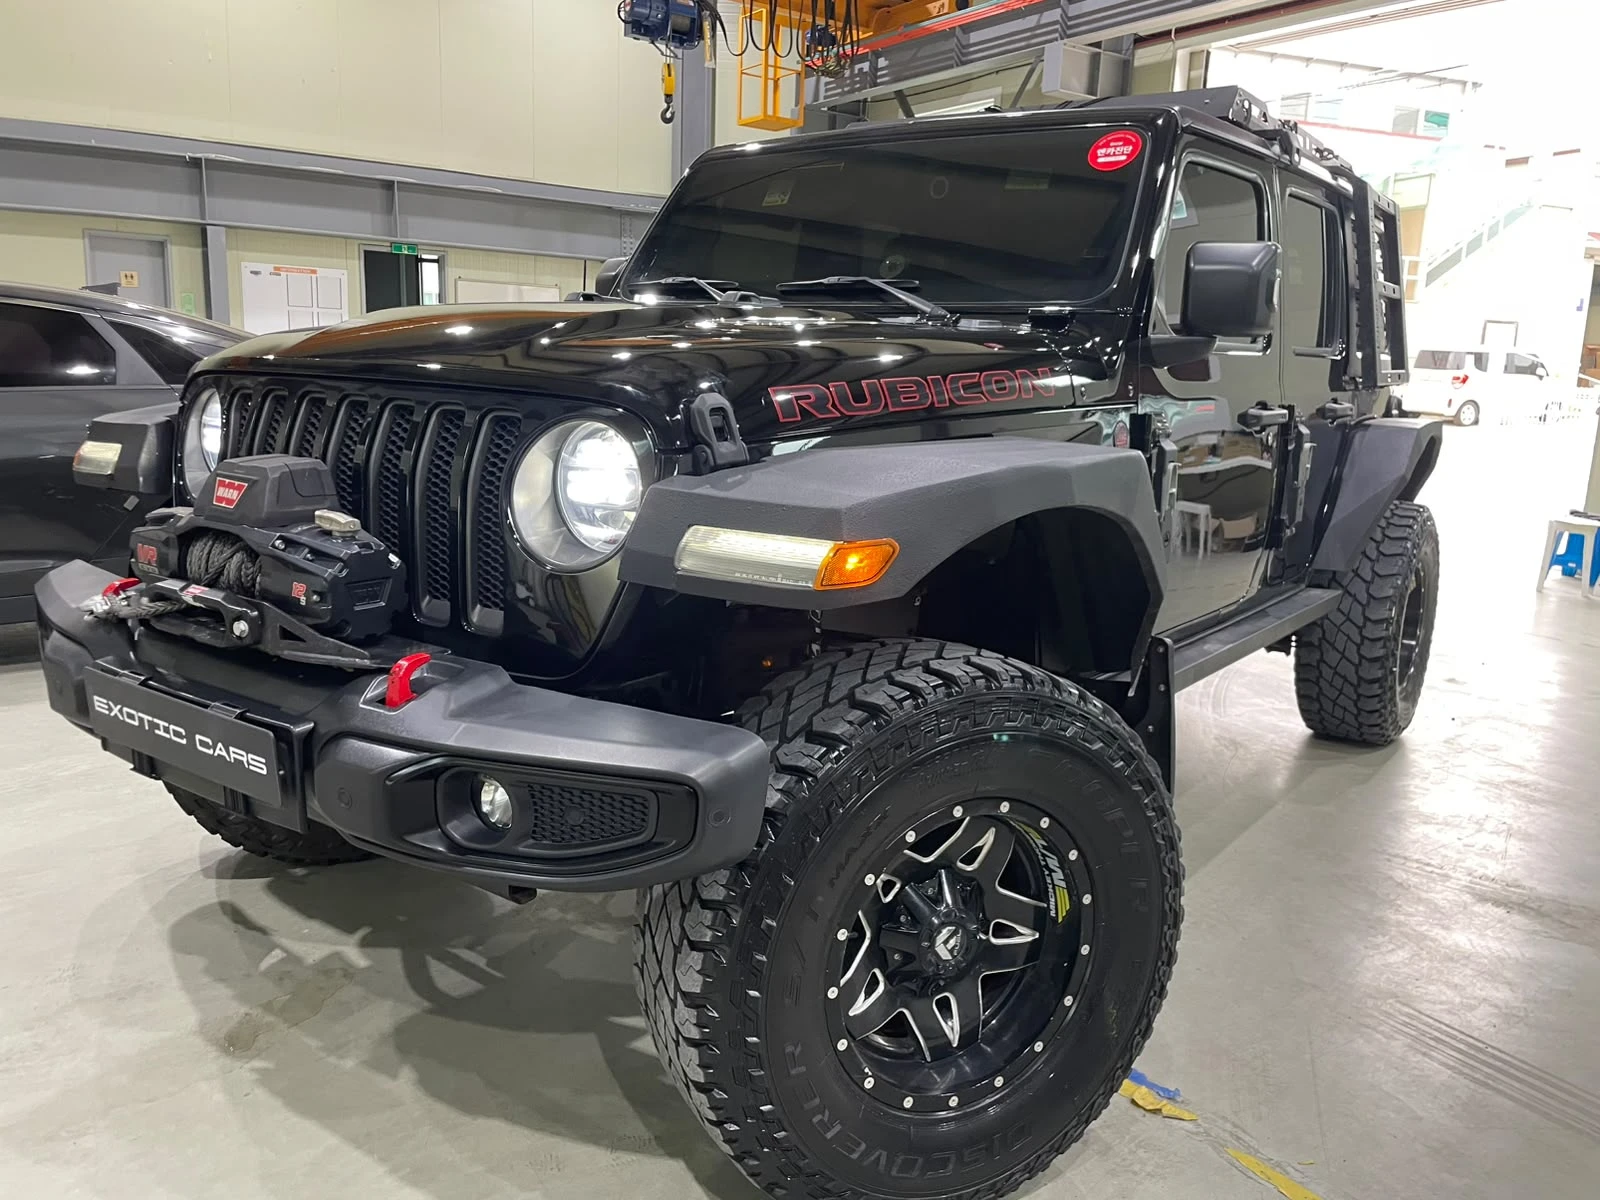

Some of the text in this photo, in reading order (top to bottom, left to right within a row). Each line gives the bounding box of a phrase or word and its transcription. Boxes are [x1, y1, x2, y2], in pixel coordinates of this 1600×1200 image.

[768, 367, 1056, 422] RUBICON
[216, 486, 240, 500] WARN
[292, 581, 307, 598] 12
[93, 695, 268, 775] EXOTIC CARS
[1036, 838, 1067, 888] M/T
[1042, 867, 1056, 918] MICKEY
[785, 1040, 1033, 1179] DISCOVERER
